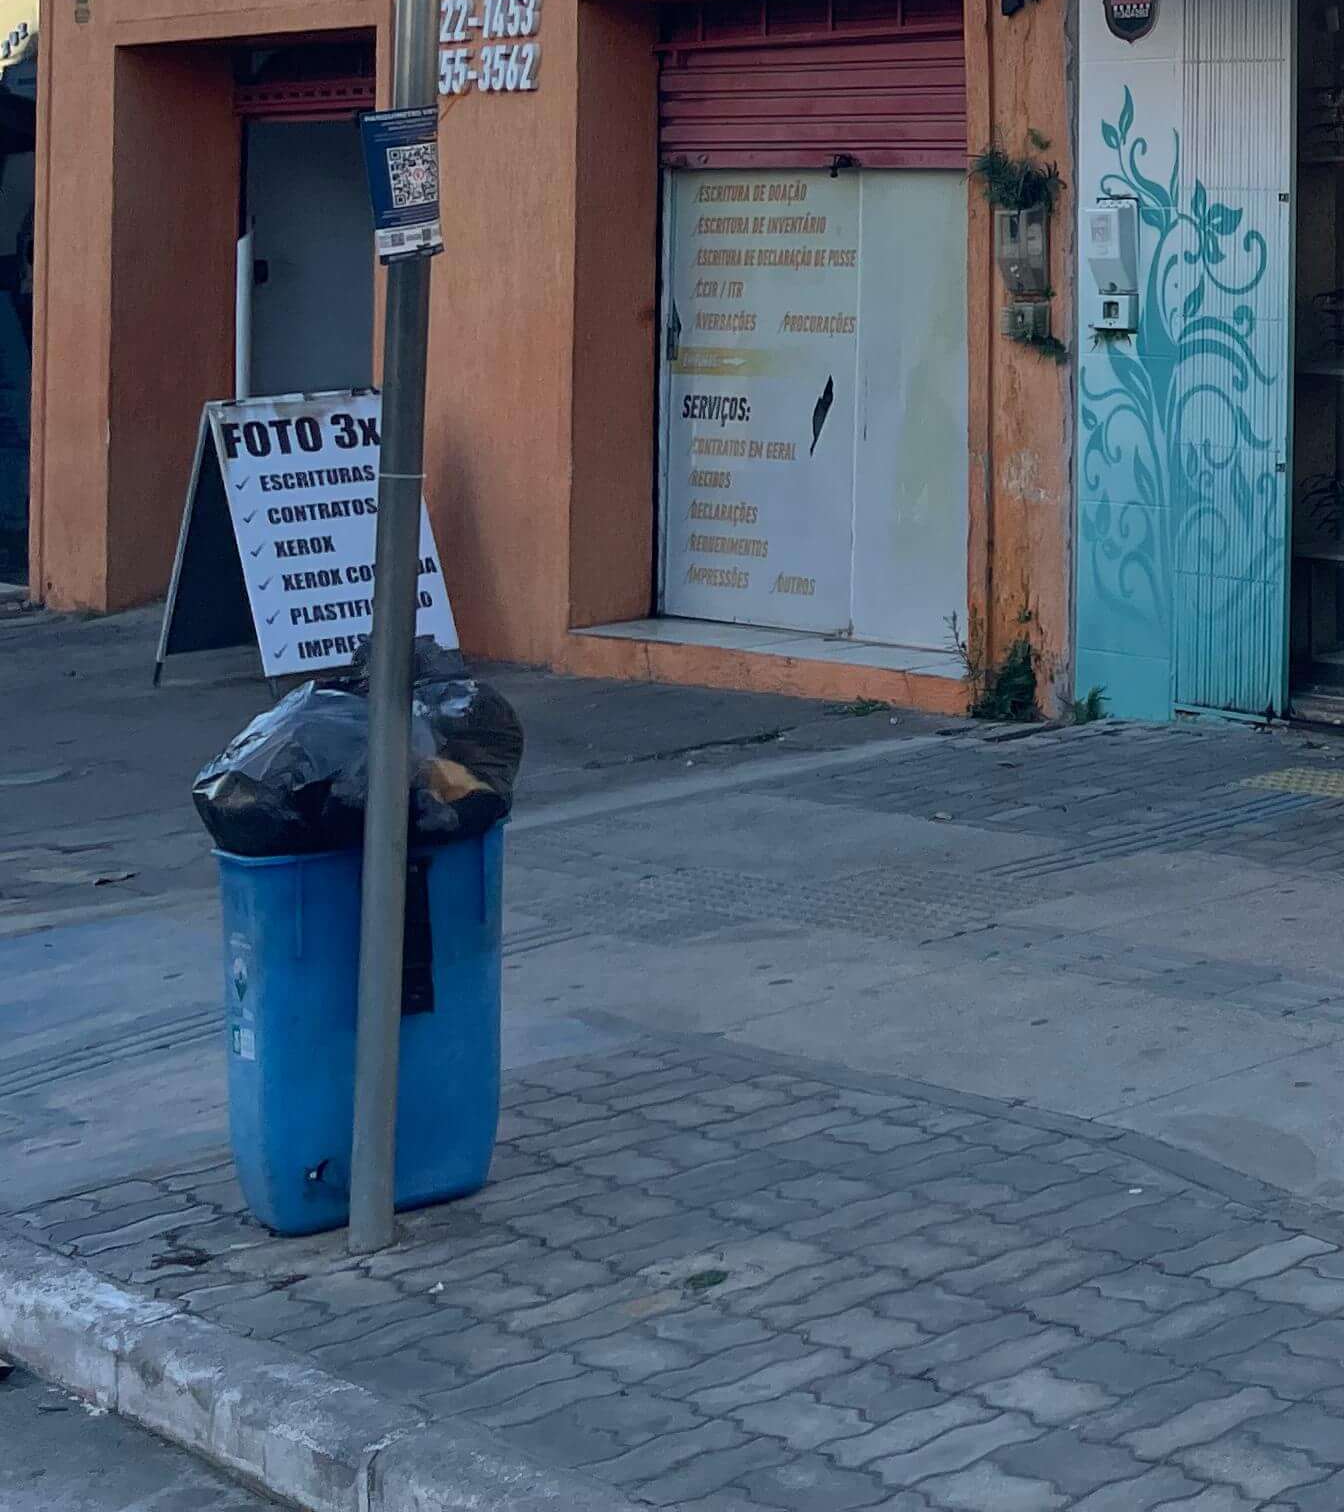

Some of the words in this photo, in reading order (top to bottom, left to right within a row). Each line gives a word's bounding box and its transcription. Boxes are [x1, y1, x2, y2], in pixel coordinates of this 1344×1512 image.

[439, 42, 541, 95] 55-3562
[752, 184, 765, 202] DE
[751, 216, 766, 234] DE
[682, 394, 751, 427] SERVIÇOS:
[220, 417, 323, 460] FOTO
[330, 413, 382, 450] 3x
[260, 465, 376, 492] ESCRITURAS
[267, 497, 378, 525] CONTRATOS
[274, 535, 336, 559] XEROX
[281, 568, 344, 593] XEROX
